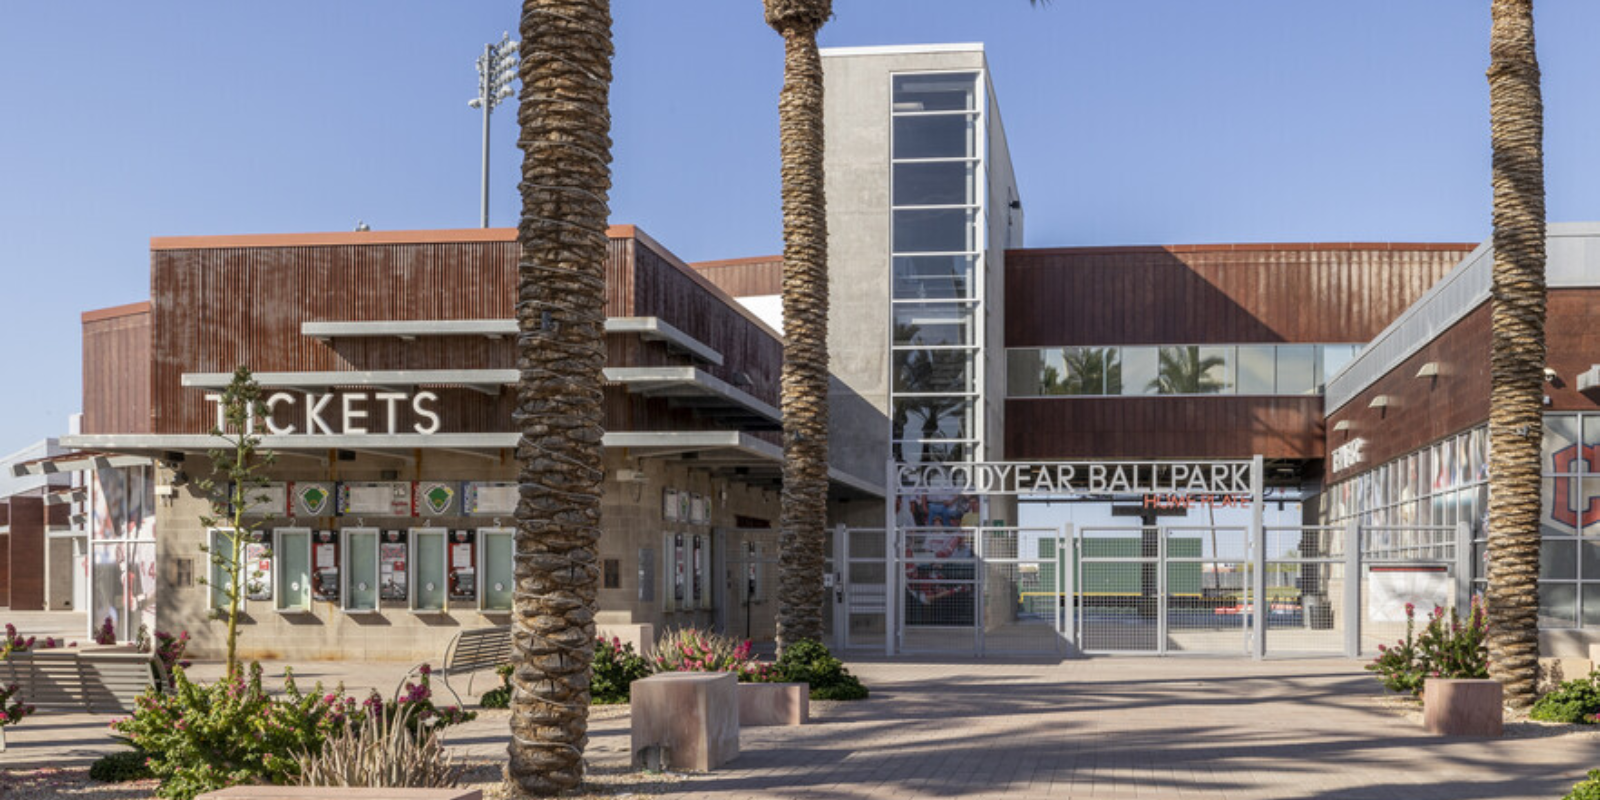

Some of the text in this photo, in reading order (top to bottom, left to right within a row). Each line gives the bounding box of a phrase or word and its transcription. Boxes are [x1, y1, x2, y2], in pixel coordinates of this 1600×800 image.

[205, 391, 441, 435] TICKETS
[898, 464, 1249, 493] GOODYEAR BALLPARK
[1143, 493, 1251, 509] HOME PLATE
[357, 517, 363, 528] 3
